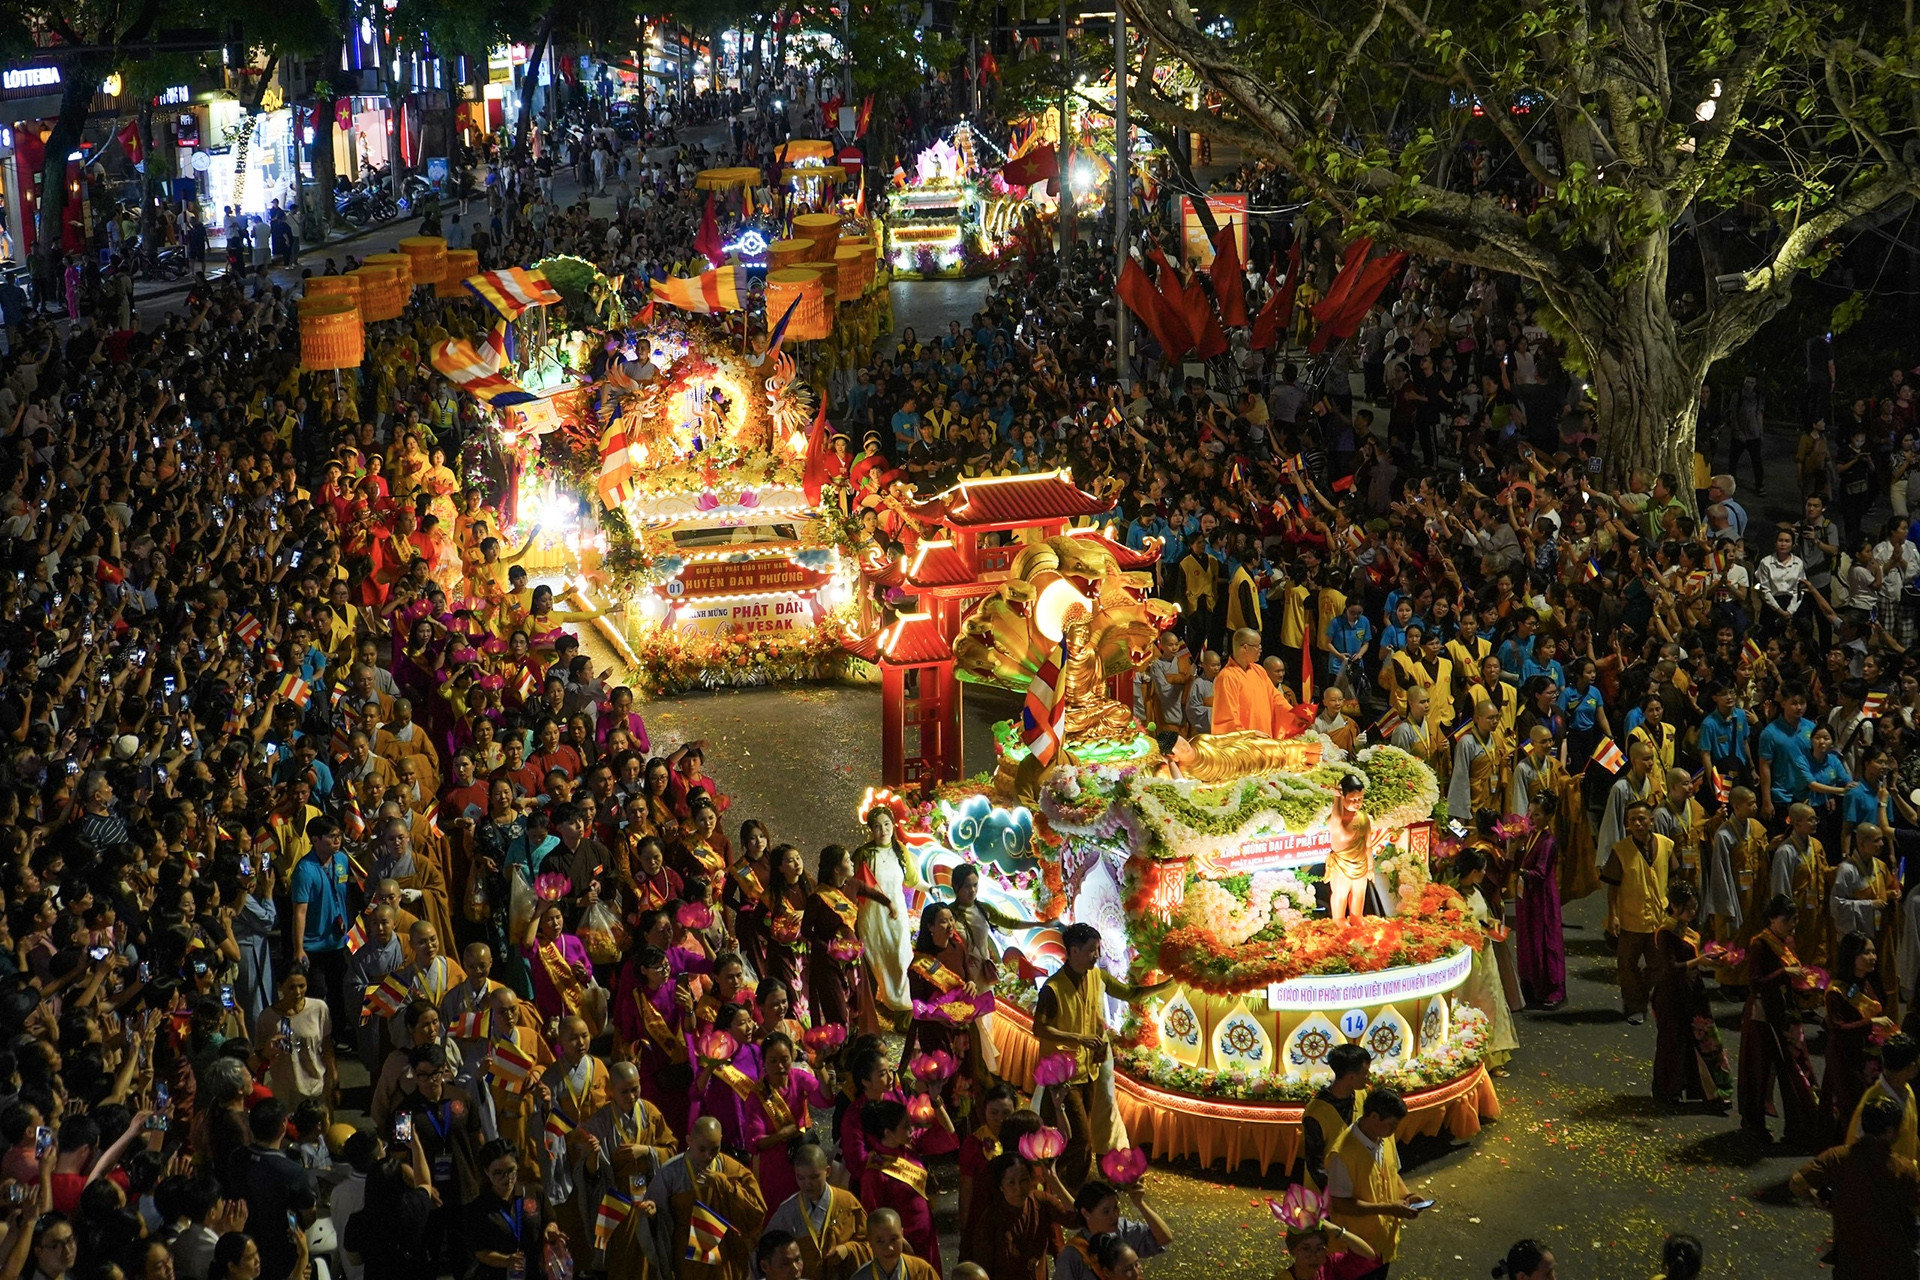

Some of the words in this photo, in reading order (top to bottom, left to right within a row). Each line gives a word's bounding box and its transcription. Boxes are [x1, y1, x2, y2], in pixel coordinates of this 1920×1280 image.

[3, 66, 61, 89] LOTTERIA
[696, 566, 711, 575] GIÁO
[712, 566, 723, 574] HỘI
[669, 583, 681, 594] 01
[685, 576, 725, 590] HUYỆN
[729, 575, 754, 587] ĐAN
[759, 571, 804, 586] PHƯỢNG
[707, 607, 728, 618] MỪNG
[733, 602, 769, 620] PHẬT
[775, 598, 804, 615] ĐẢN
[746, 618, 793, 633] VESAK
[1268, 839, 1283, 853] ĐẠI
[1295, 834, 1317, 849] PHẬT
[1277, 985, 1299, 1002] GIÁO
[1300, 985, 1317, 1005] HỘI
[1318, 984, 1342, 1005] PHẬT
[1342, 983, 1364, 1001] GIÁO
[1364, 980, 1381, 1000] VIỆT
[1382, 979, 1401, 996] NAM
[1401, 973, 1426, 992] HUYỆN
[1345, 1015, 1364, 1032] 14
